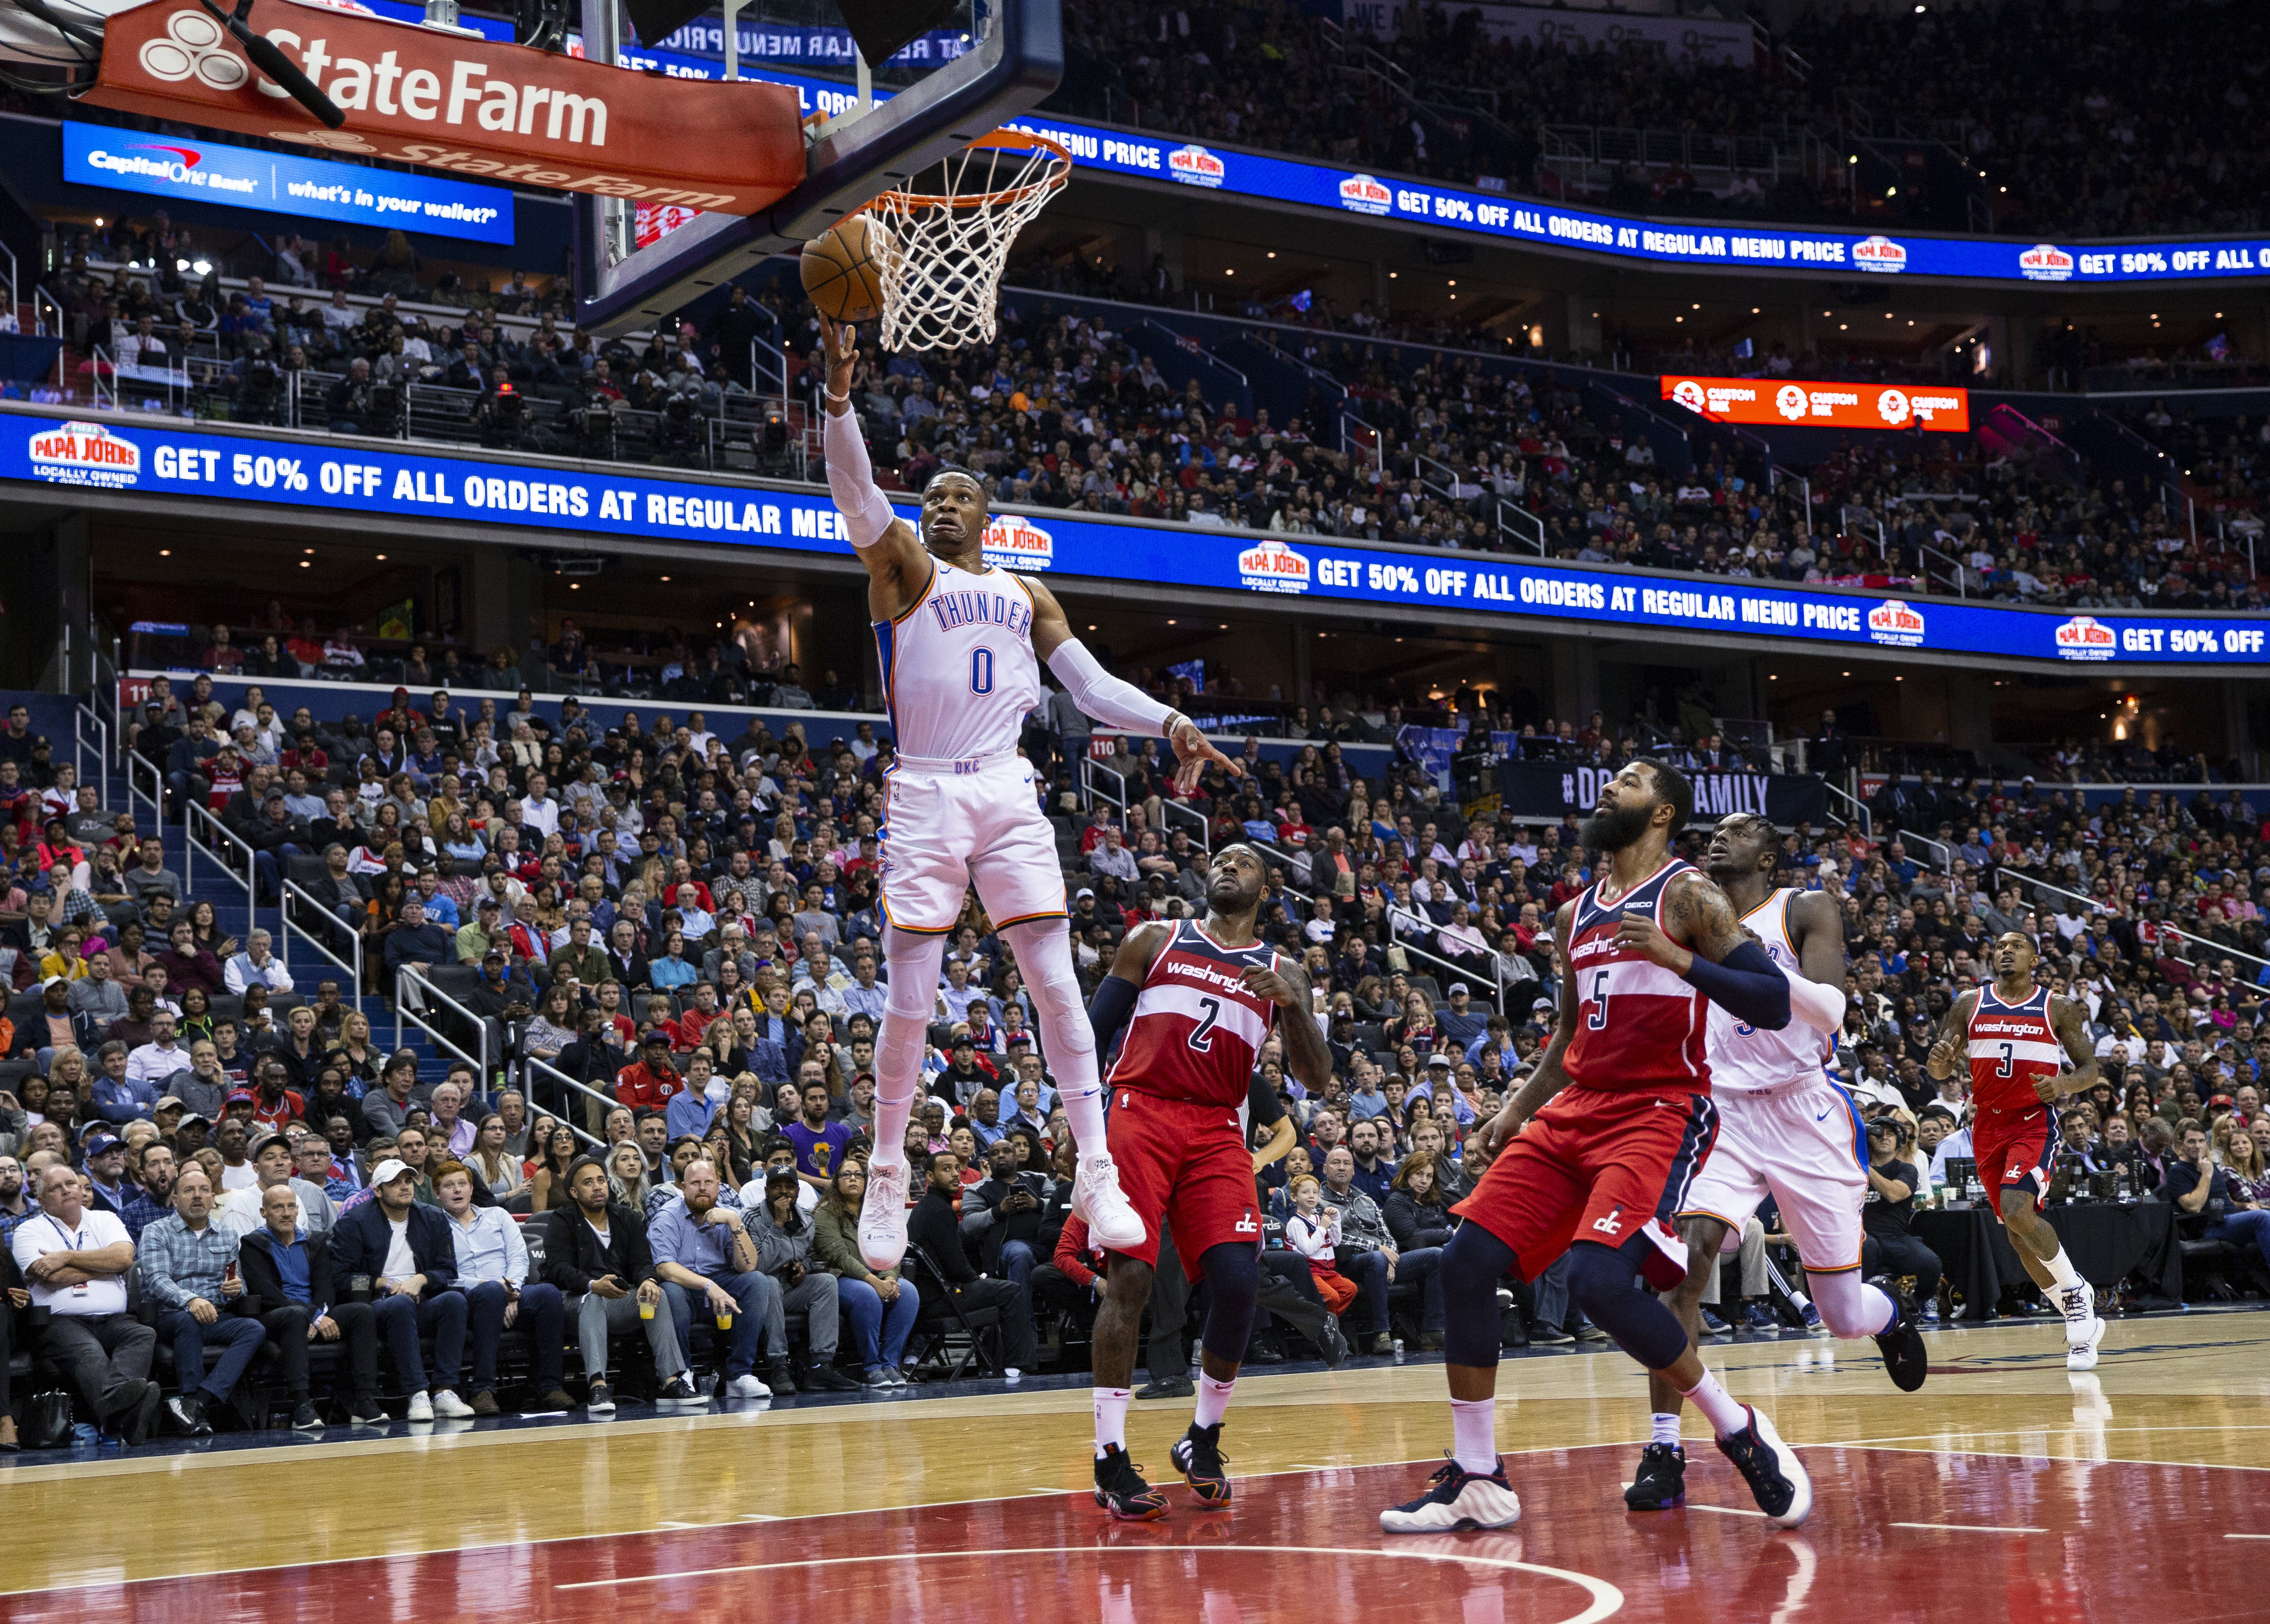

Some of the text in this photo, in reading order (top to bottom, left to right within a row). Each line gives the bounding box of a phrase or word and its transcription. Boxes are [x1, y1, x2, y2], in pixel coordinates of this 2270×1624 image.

[1103, 139, 1161, 170] PRICE
[208, 173, 255, 194] Bank
[287, 179, 352, 204] what's
[354, 189, 373, 207] in
[377, 195, 421, 216] your
[1398, 190, 1431, 215] GET
[1435, 197, 1474, 222] 50%
[1477, 204, 1509, 228] OFF
[1513, 210, 1545, 234] ALL
[1548, 216, 1613, 245] ORDERS
[1617, 228, 1639, 248] AT
[1642, 231, 1726, 256] REGULAR
[1731, 237, 1786, 259] MENU
[1790, 240, 1845, 262] PRICE
[2079, 254, 2116, 274] GET
[2121, 252, 2167, 273] 50%
[2172, 250, 2210, 271] OFF
[2216, 249, 2254, 269] ALL
[1707, 387, 1756, 401] CUSTOM
[1809, 392, 1858, 406] CUSTOM
[1910, 396, 1958, 410] CUSTOM
[35, 437, 77, 460] PAPA
[33, 464, 88, 480] LOCALLY
[154, 445, 850, 542] GET 50% OFF ALL ORDERS AT REGULAR MEN
[1317, 558, 1362, 587] GET
[1369, 564, 1419, 593] 50%
[1425, 568, 1467, 596] OFF
[1473, 574, 1515, 601] ALL
[1520, 577, 1605, 609] ORDERS
[1610, 586, 1636, 612] AT
[1642, 589, 1736, 621] REGULAR
[1741, 598, 1798, 626] MENU
[1803, 603, 1861, 631] PRICE
[927, 590, 1032, 641] THUNDER
[2123, 628, 2164, 652] GET
[2170, 629, 2219, 652] 50%
[2224, 629, 2265, 653] OFF
[969, 645, 996, 697] 0
[129, 685, 153, 702] 11
[1093, 740, 1115, 756] 110
[954, 759, 981, 775] OKC
[1864, 784, 1882, 797] 10
[1242, 954, 1268, 967] GEICO
[1587, 970, 1609, 1031] 5
[1188, 996, 1220, 1053] 2
[1974, 1019, 2044, 1037] washington
[1996, 1042, 2013, 1078] 3
